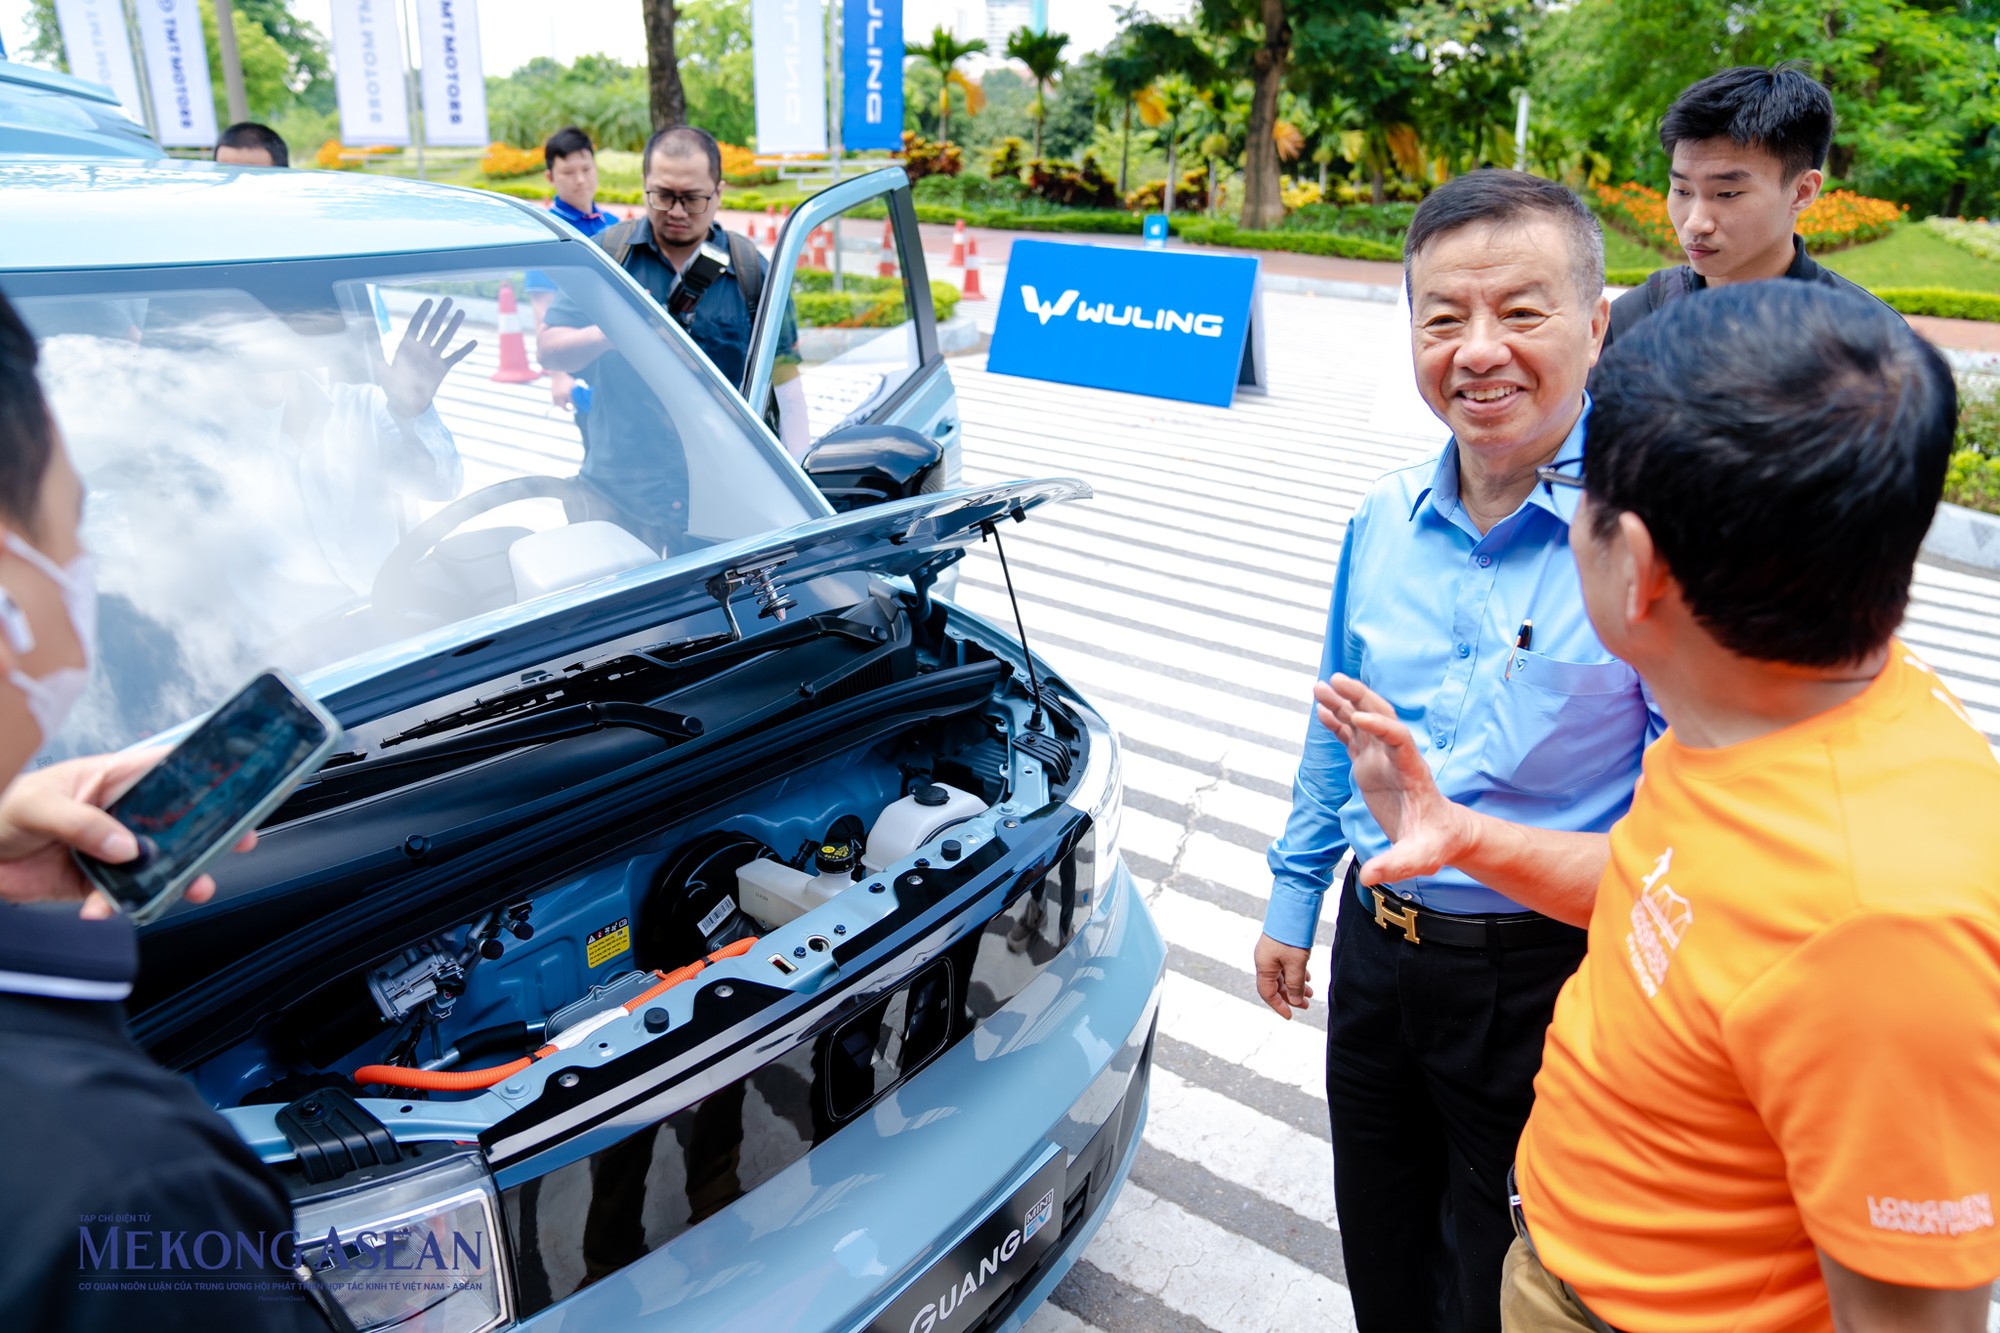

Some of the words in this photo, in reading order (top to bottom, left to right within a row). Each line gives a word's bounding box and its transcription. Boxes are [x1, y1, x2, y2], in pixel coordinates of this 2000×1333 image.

[1076, 300, 1224, 338] WULING
[1026, 1193, 1052, 1224] MINI
[1026, 1208, 1049, 1238] EV
[908, 1228, 1021, 1333] GUANG
